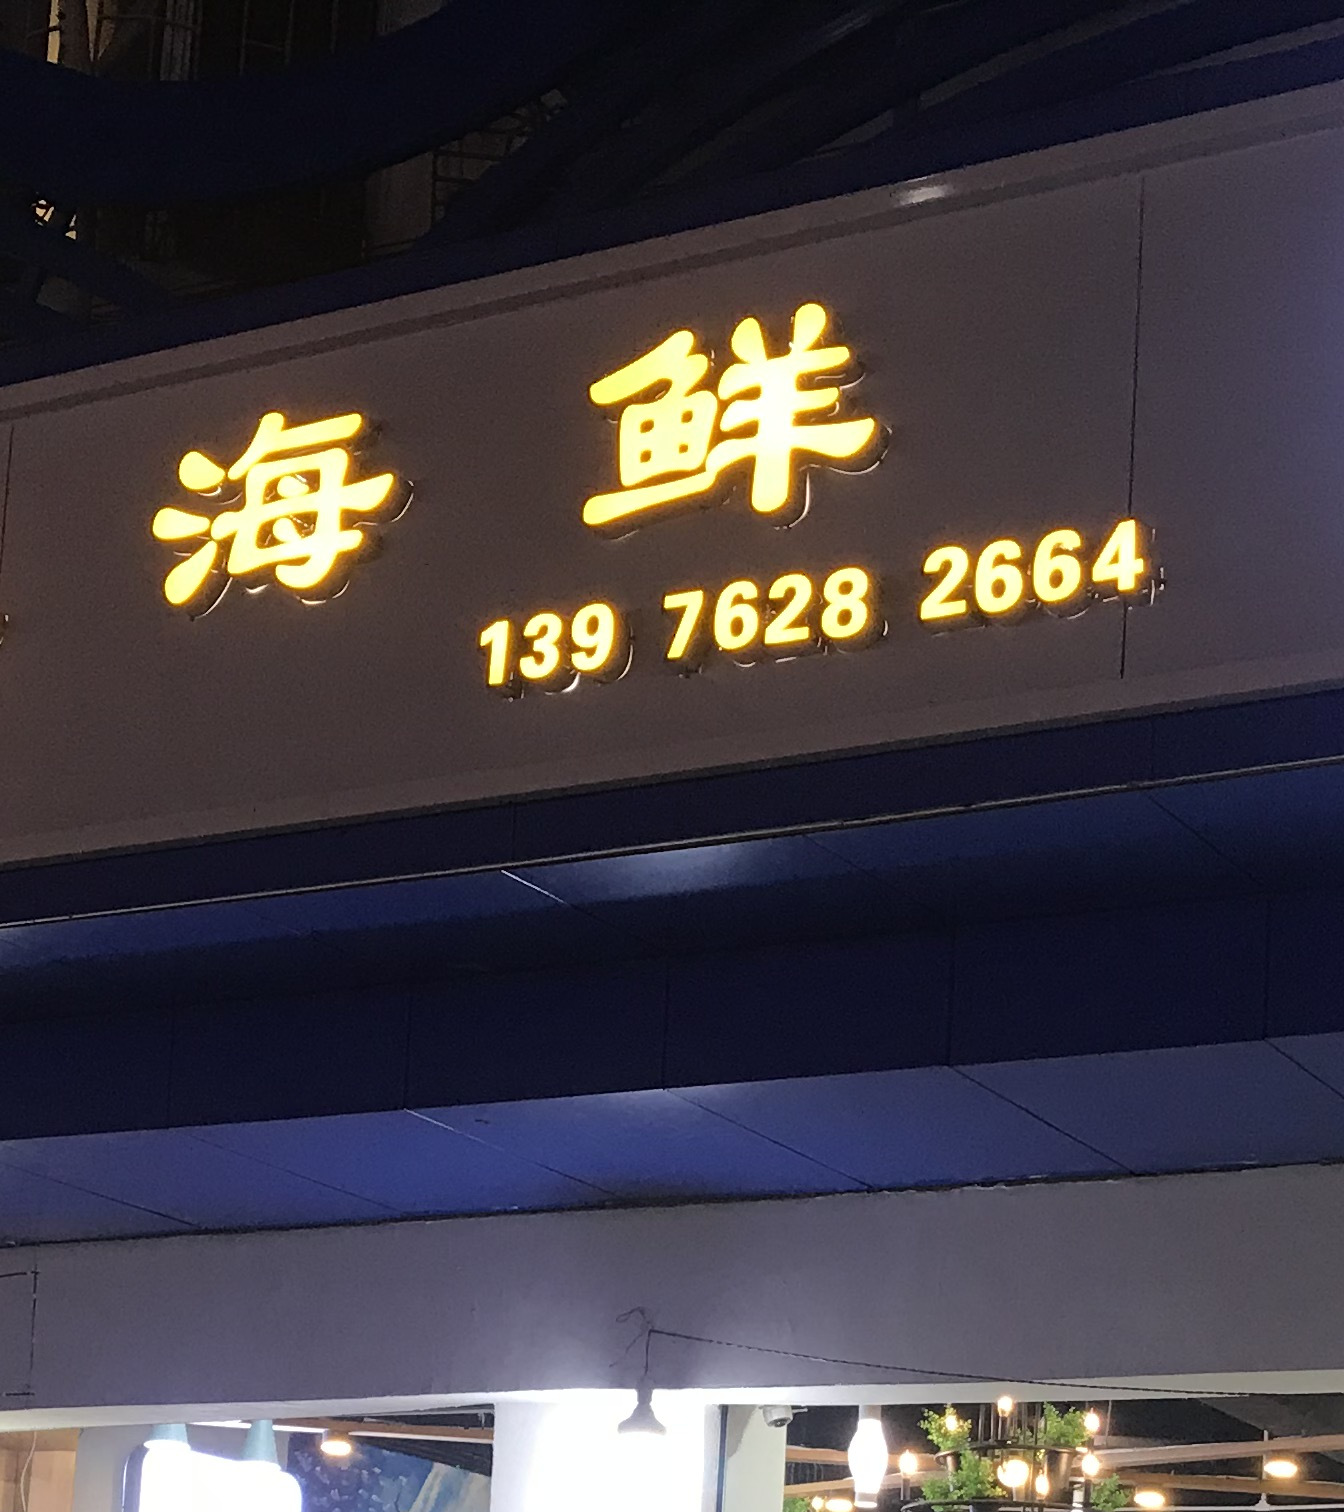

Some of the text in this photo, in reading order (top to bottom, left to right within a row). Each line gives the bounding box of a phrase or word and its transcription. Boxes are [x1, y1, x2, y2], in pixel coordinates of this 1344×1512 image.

[477, 517, 1146, 688] 139 7628 2664
